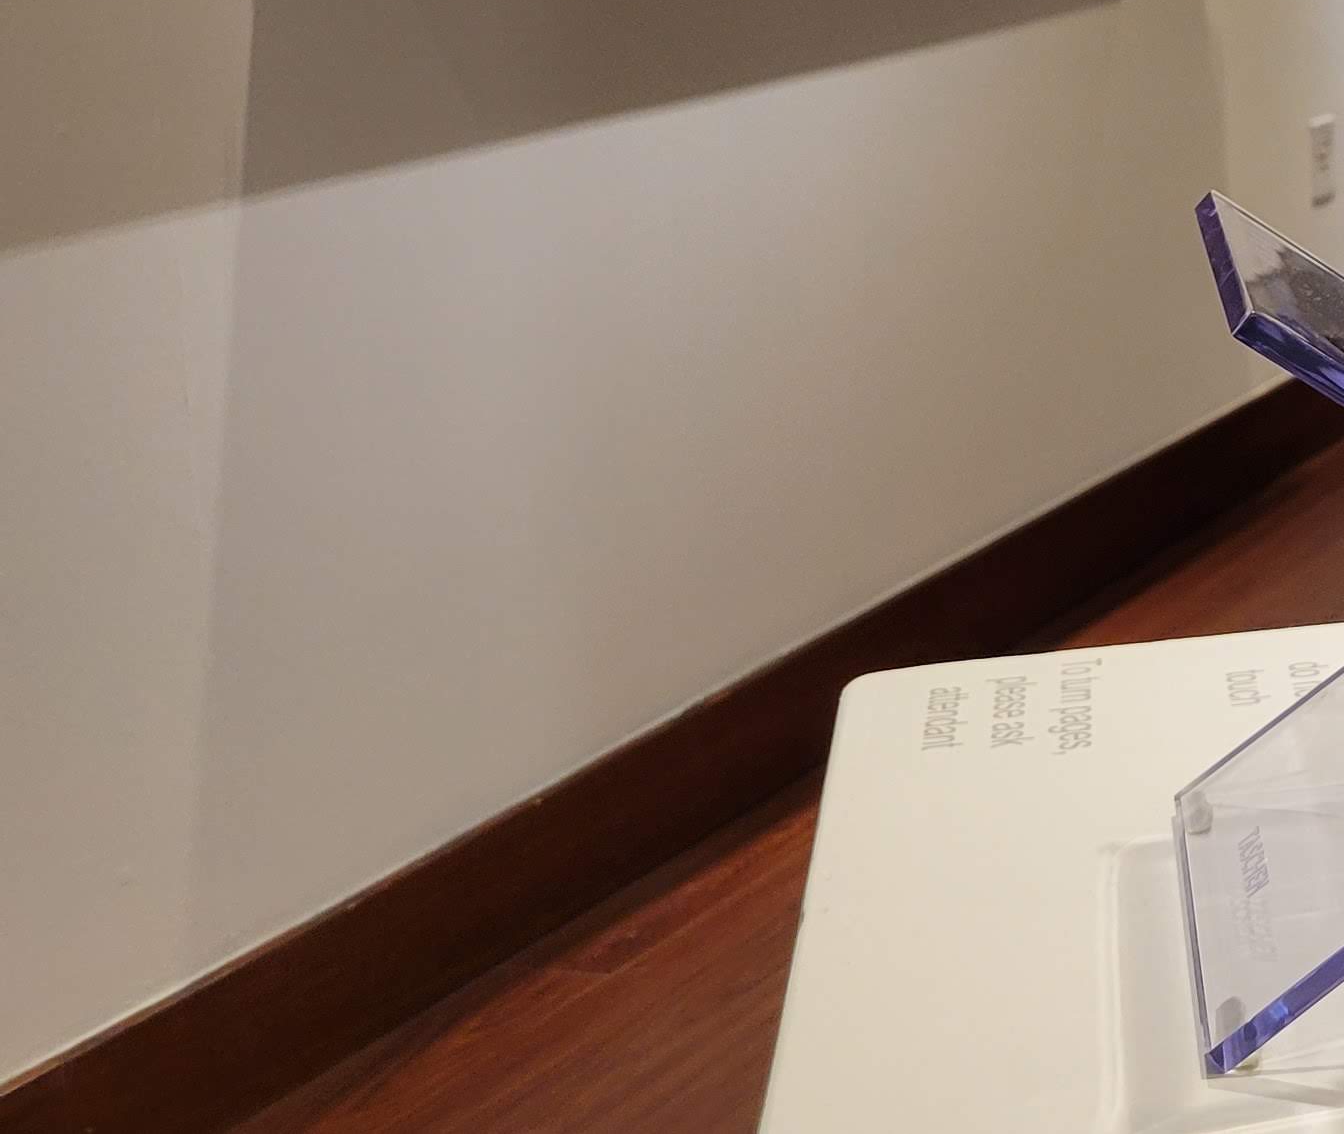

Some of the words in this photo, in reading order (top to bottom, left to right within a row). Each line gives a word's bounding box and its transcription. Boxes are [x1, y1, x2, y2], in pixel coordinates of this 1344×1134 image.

[1061, 658, 1102, 676] To
[1225, 669, 1271, 707] touch
[921, 686, 969, 750] attendant
[986, 676, 1038, 719] please
[990, 722, 1034, 749] ask
[1048, 706, 1094, 755] pages,
[1238, 826, 1269, 899] TASCHEN
